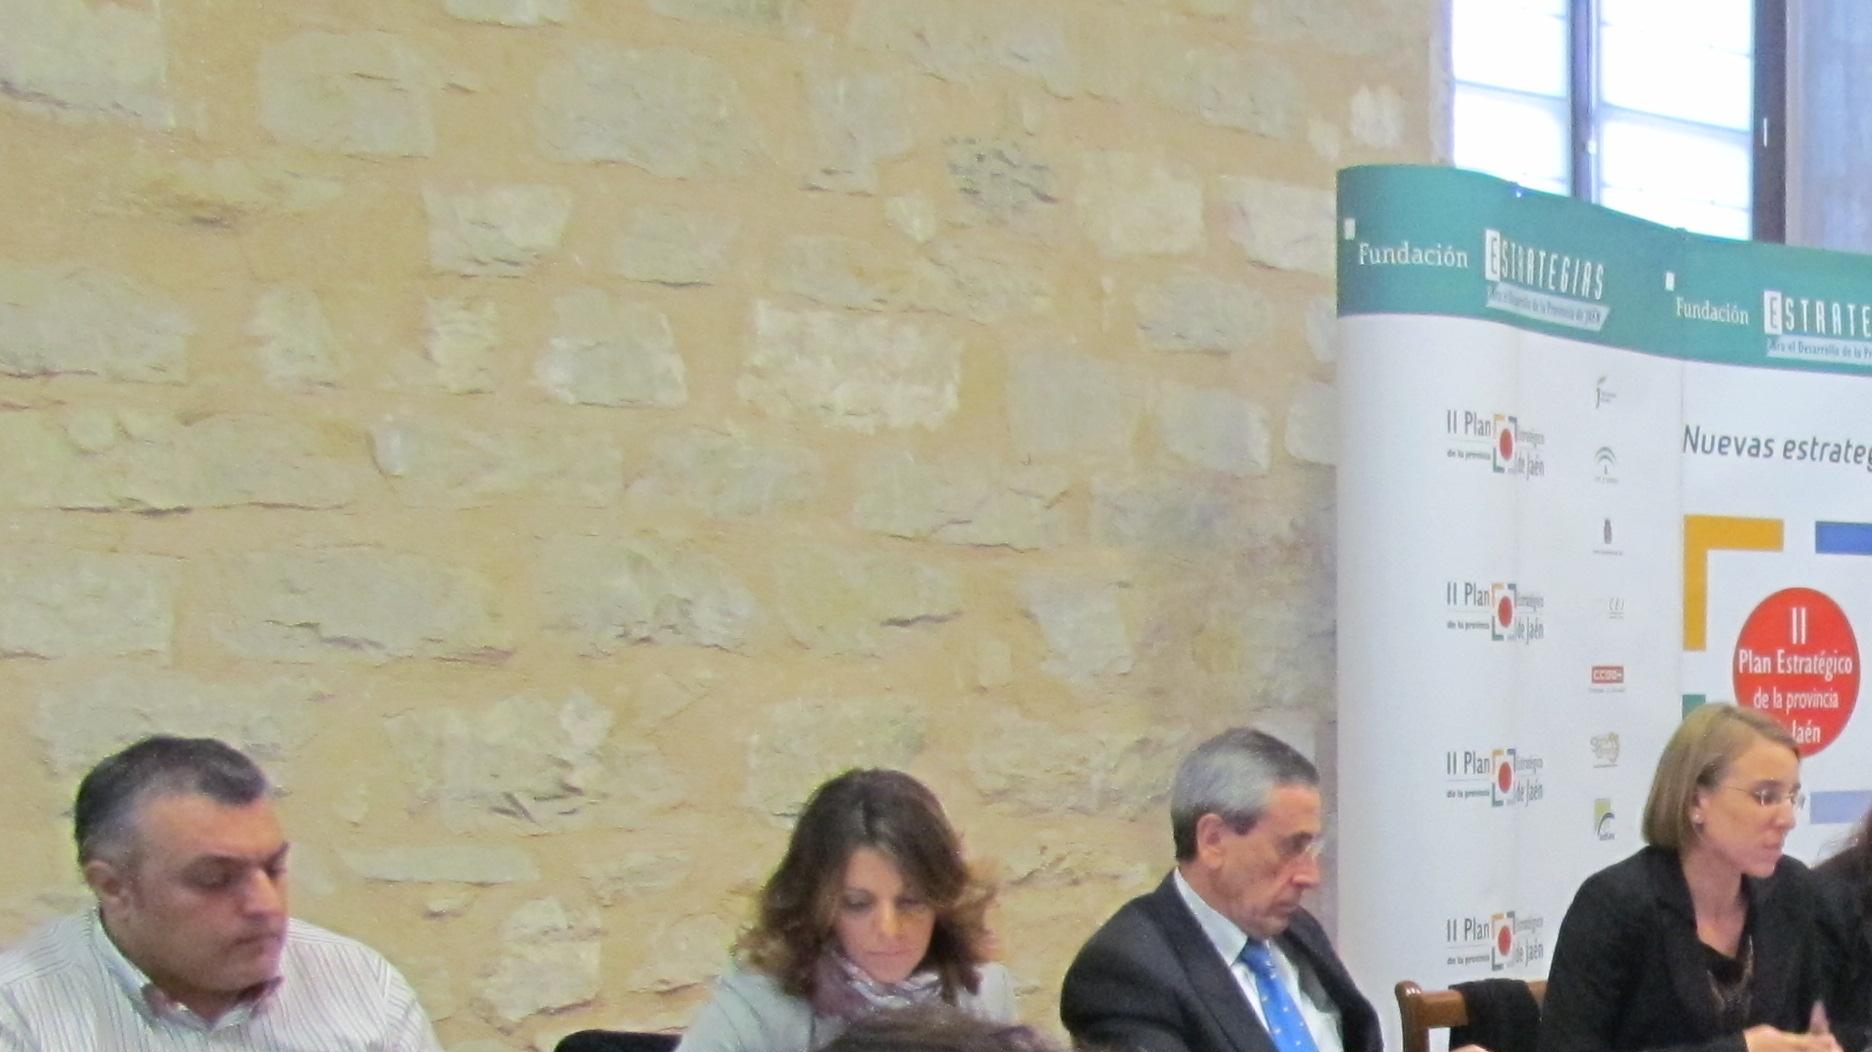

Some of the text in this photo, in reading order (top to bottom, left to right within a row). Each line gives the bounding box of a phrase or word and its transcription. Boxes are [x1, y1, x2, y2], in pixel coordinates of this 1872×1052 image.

[1358, 241, 1469, 269] Fundación
[1486, 229, 1604, 300] ESTRATEGIAS
[1676, 297, 1750, 325] Fundación
[1464, 411, 1491, 436] Plan
[1683, 424, 1775, 459] Nuevas
[1464, 582, 1490, 606] Plan
[1791, 607, 1807, 644] II
[1738, 649, 1853, 682] Plan Estratégico
[1753, 687, 1839, 714] de la provincia
[1464, 751, 1490, 774] Plan
[1464, 918, 1489, 941] Plan
